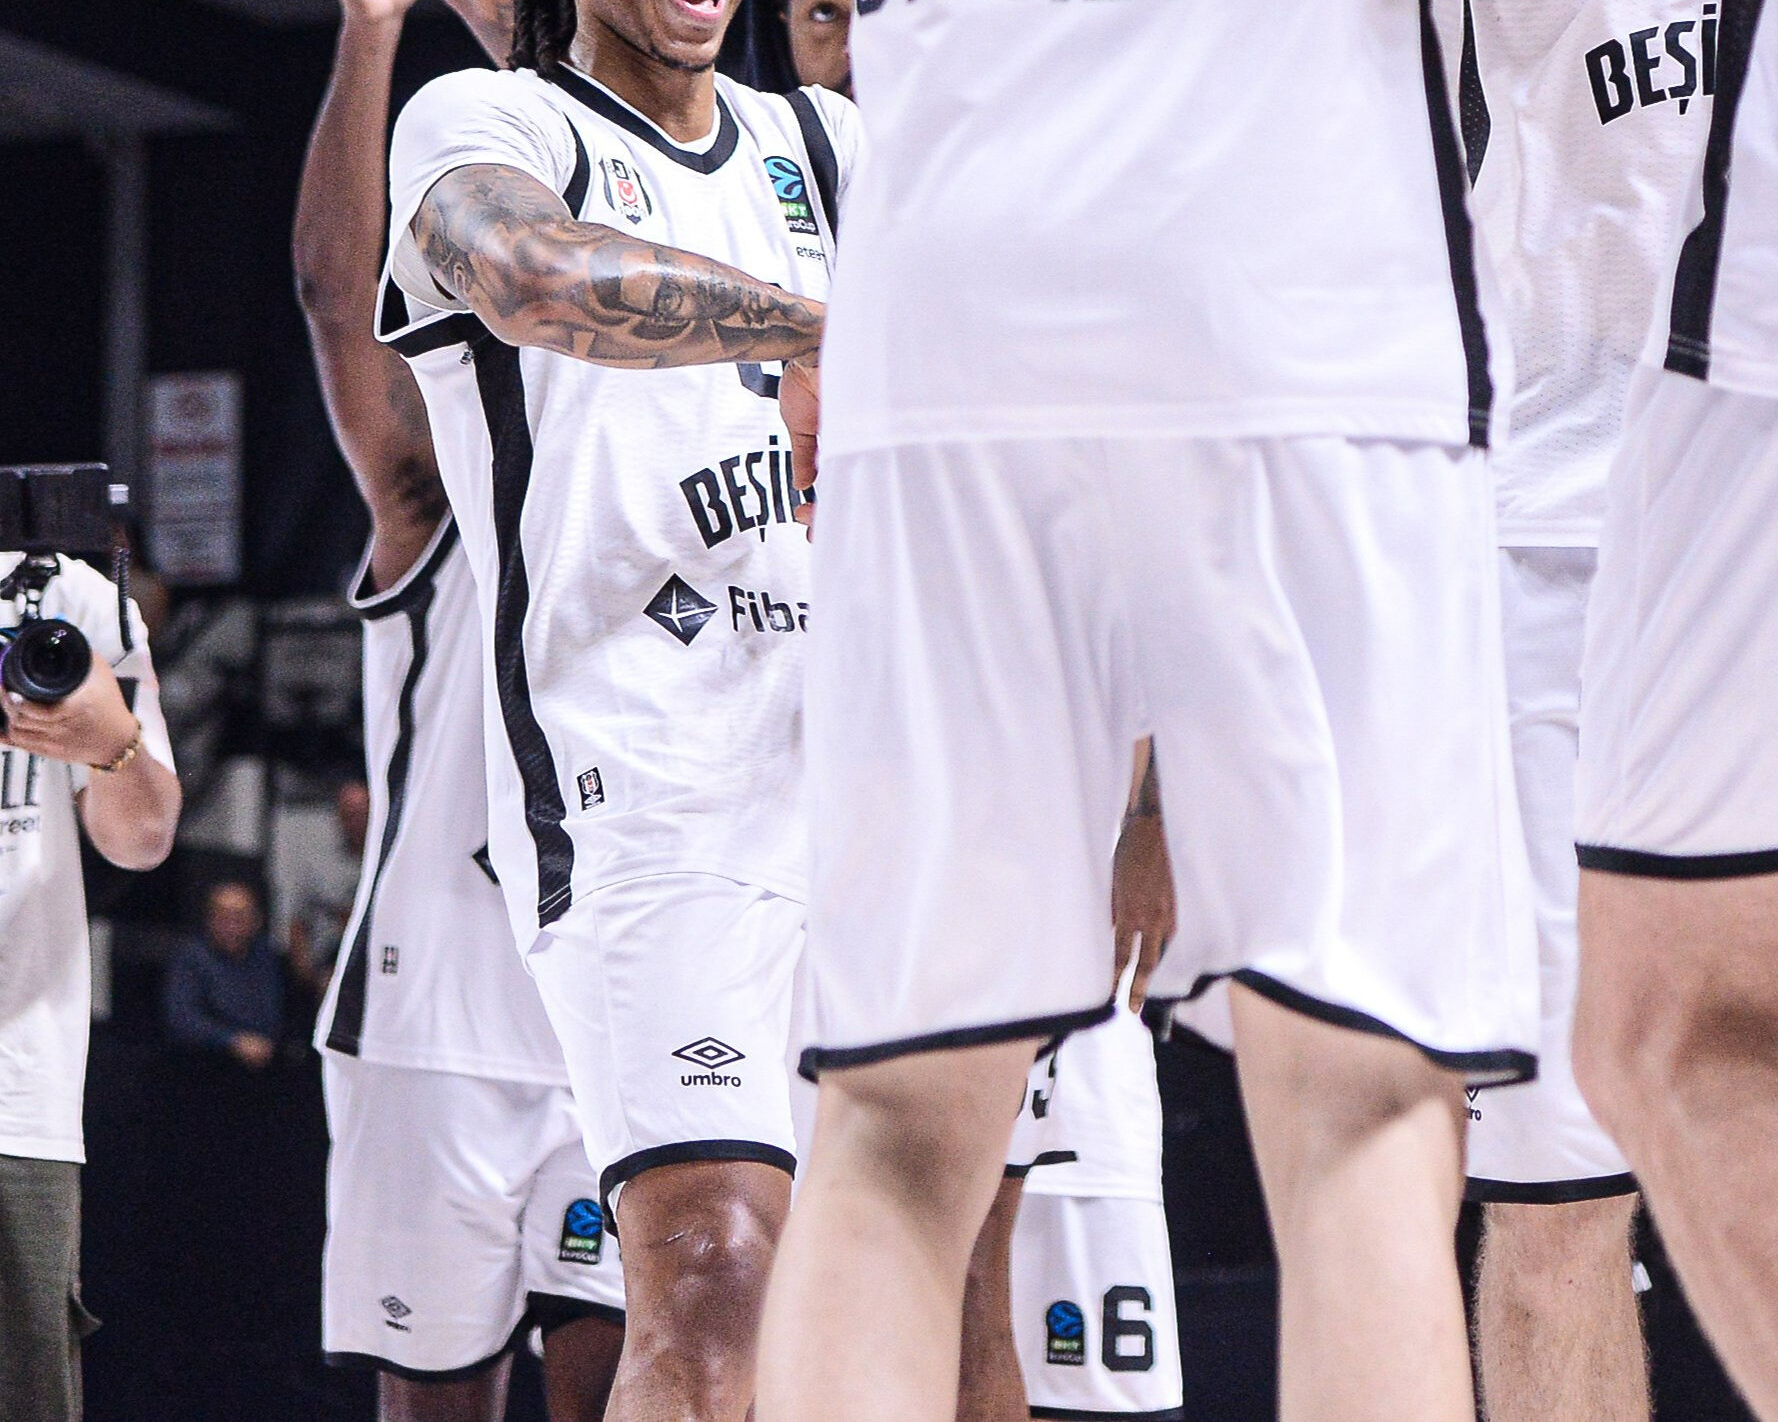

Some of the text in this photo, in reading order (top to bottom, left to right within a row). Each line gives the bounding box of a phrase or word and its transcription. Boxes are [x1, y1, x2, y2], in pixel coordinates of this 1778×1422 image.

[1585, 3, 1717, 125] BEŞİ
[681, 1072, 742, 1087] umbro
[1102, 1285, 1153, 1371] 6
